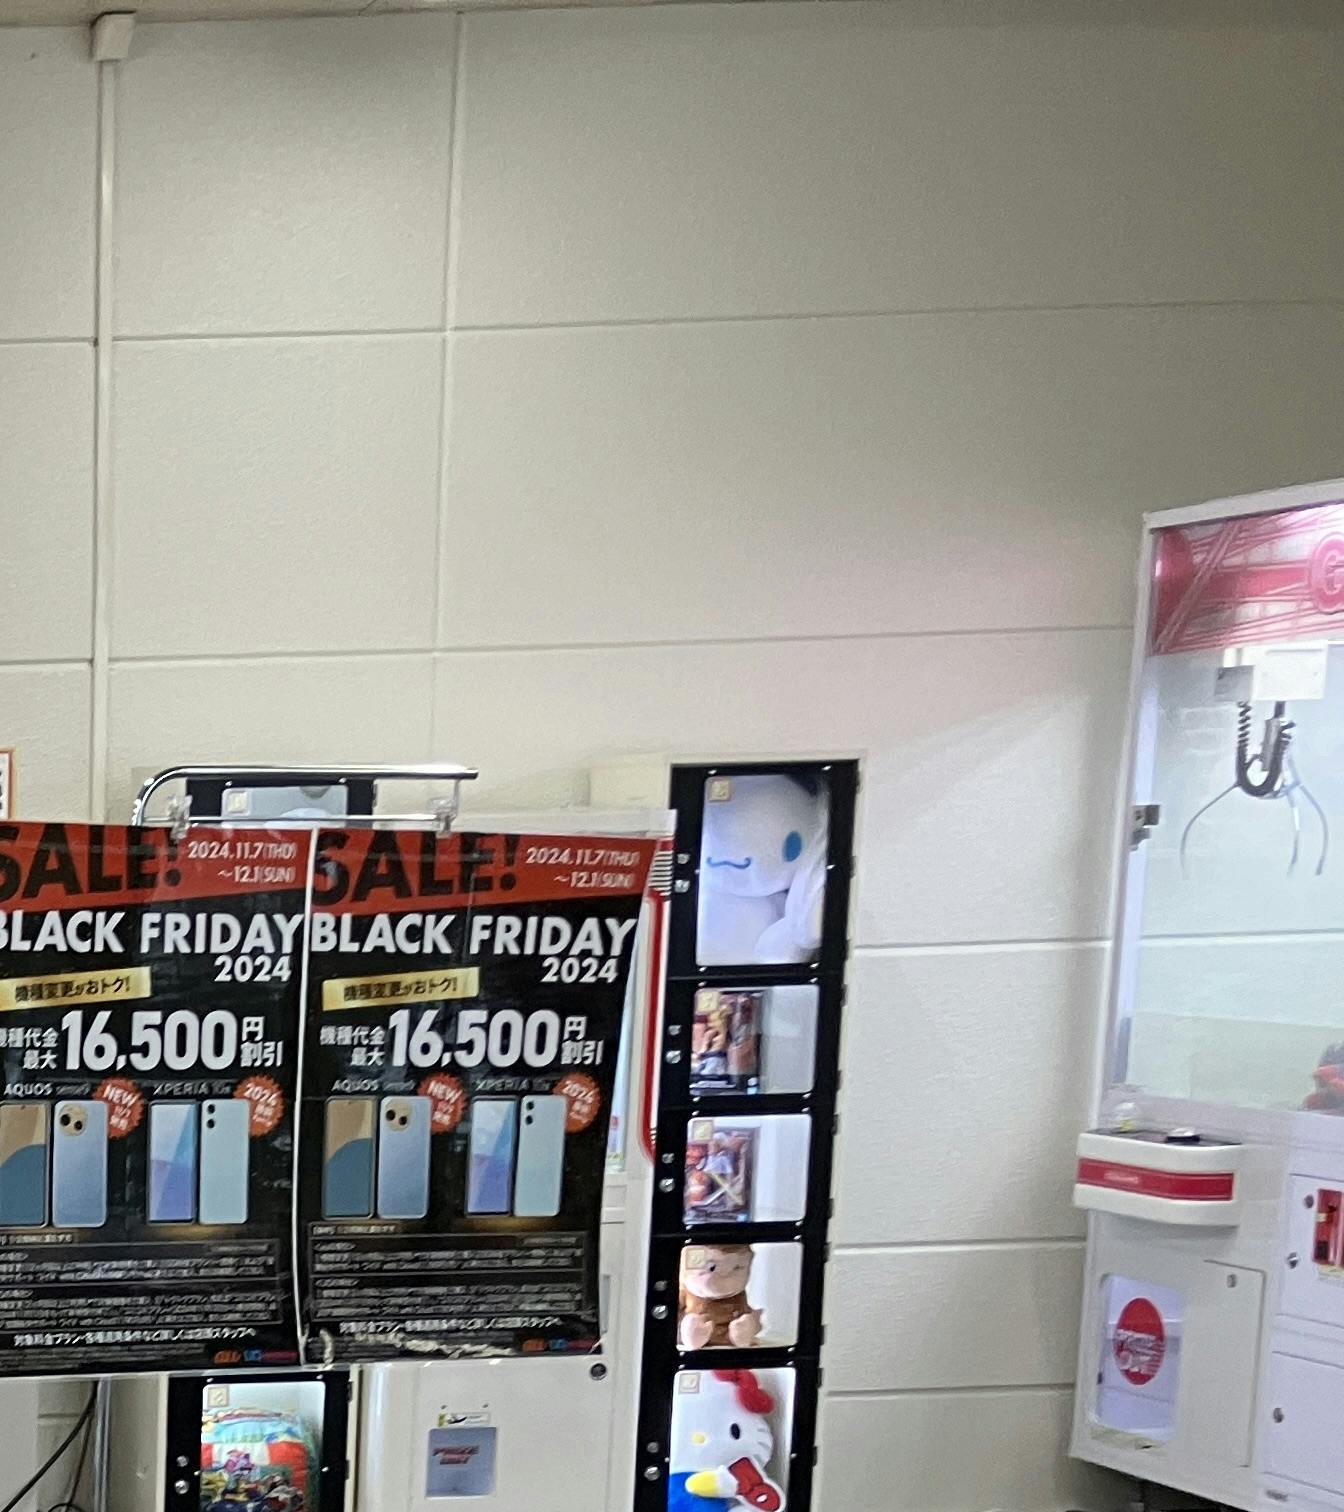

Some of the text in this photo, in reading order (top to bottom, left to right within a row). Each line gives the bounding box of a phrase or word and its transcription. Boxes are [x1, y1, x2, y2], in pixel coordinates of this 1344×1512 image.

[313, 827, 521, 906] SALE!
[138, 912, 306, 955] FRIDAY
[310, 912, 639, 956] BLACK FRIDAY
[212, 955, 292, 983] 2024
[540, 956, 621, 984] 2024
[22, 1009, 266, 1072] 最大 16,500 円
[319, 1025, 386, 1047] 機種代金
[349, 1008, 588, 1068] 最大 16,500 円
[239, 1040, 284, 1069] 割引
[560, 1039, 605, 1066] 割引
[3, 1083, 53, 1097] AQUOS
[153, 1083, 208, 1096] XPERIA
